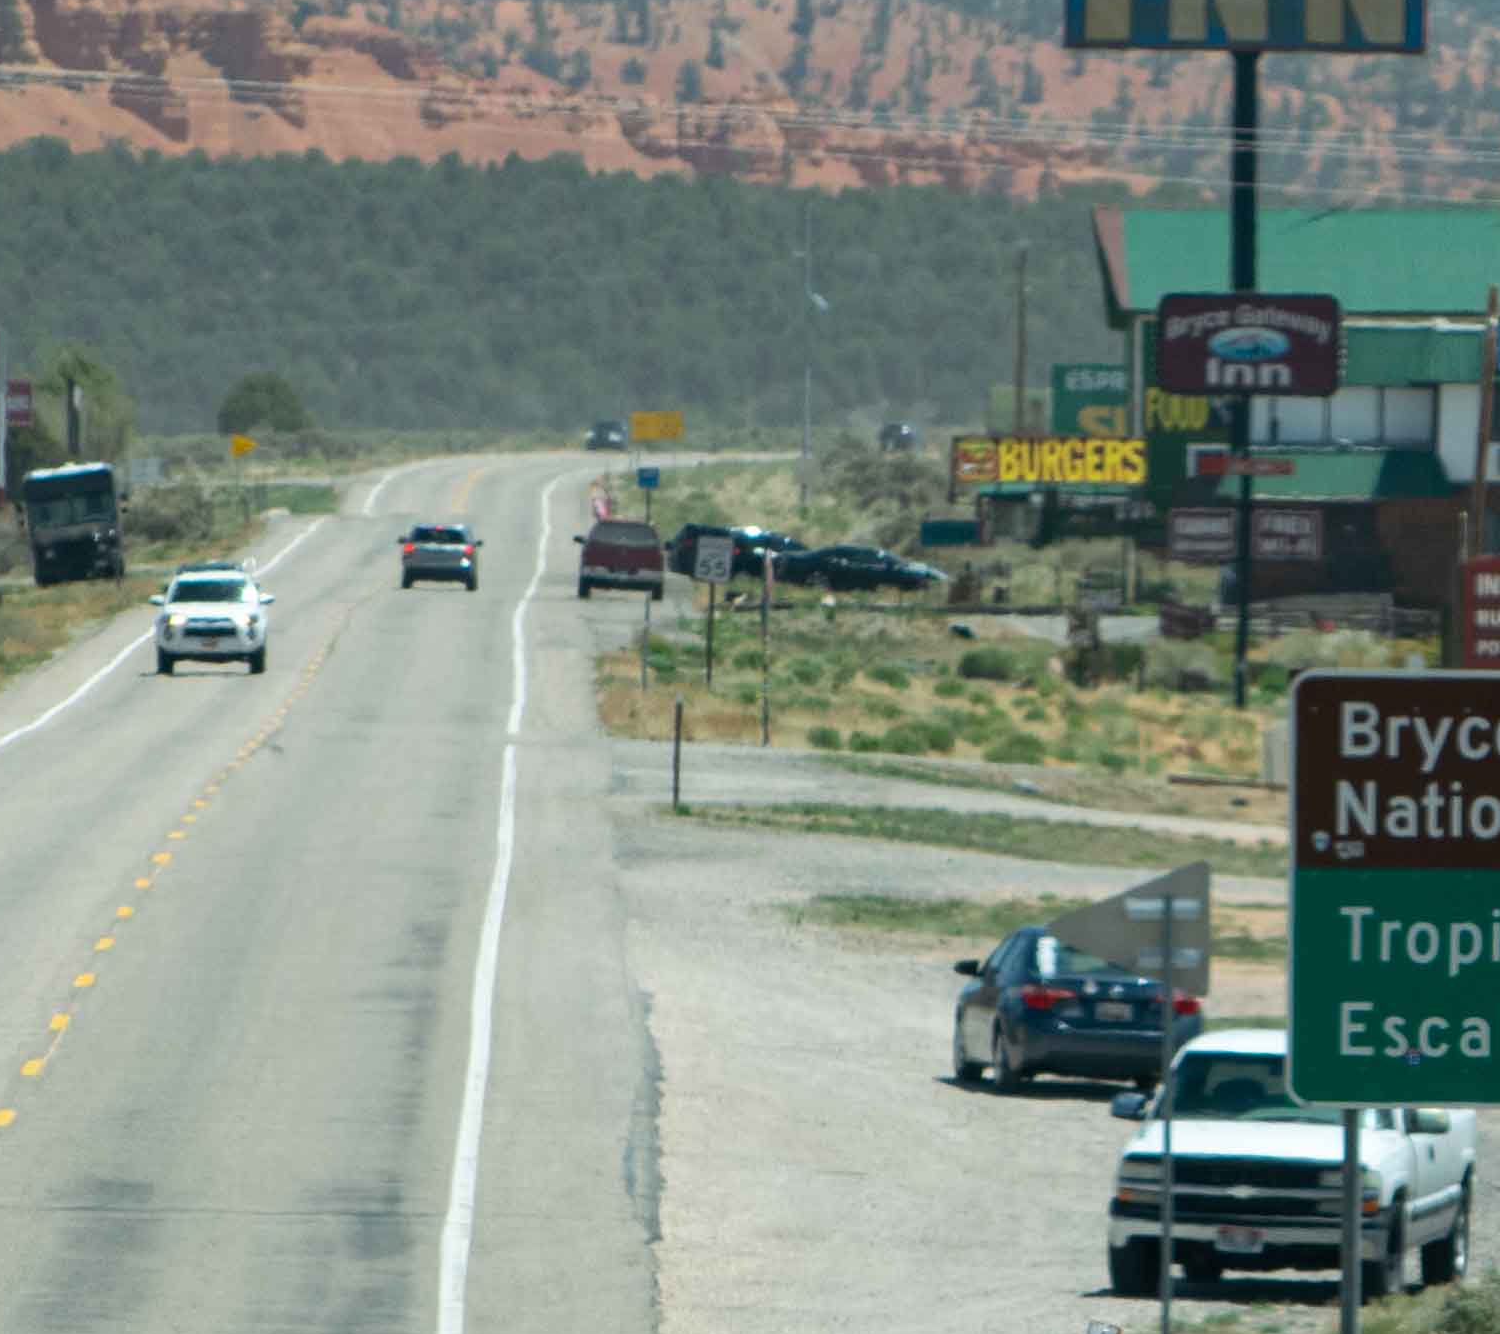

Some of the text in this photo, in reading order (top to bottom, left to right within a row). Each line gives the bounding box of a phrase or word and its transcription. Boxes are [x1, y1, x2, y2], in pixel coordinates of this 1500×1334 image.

[1166, 310, 1231, 340] Bryce
[1206, 358, 1293, 386] Inn
[998, 439, 1148, 484] BURGERS
[700, 558, 729, 578] 55
